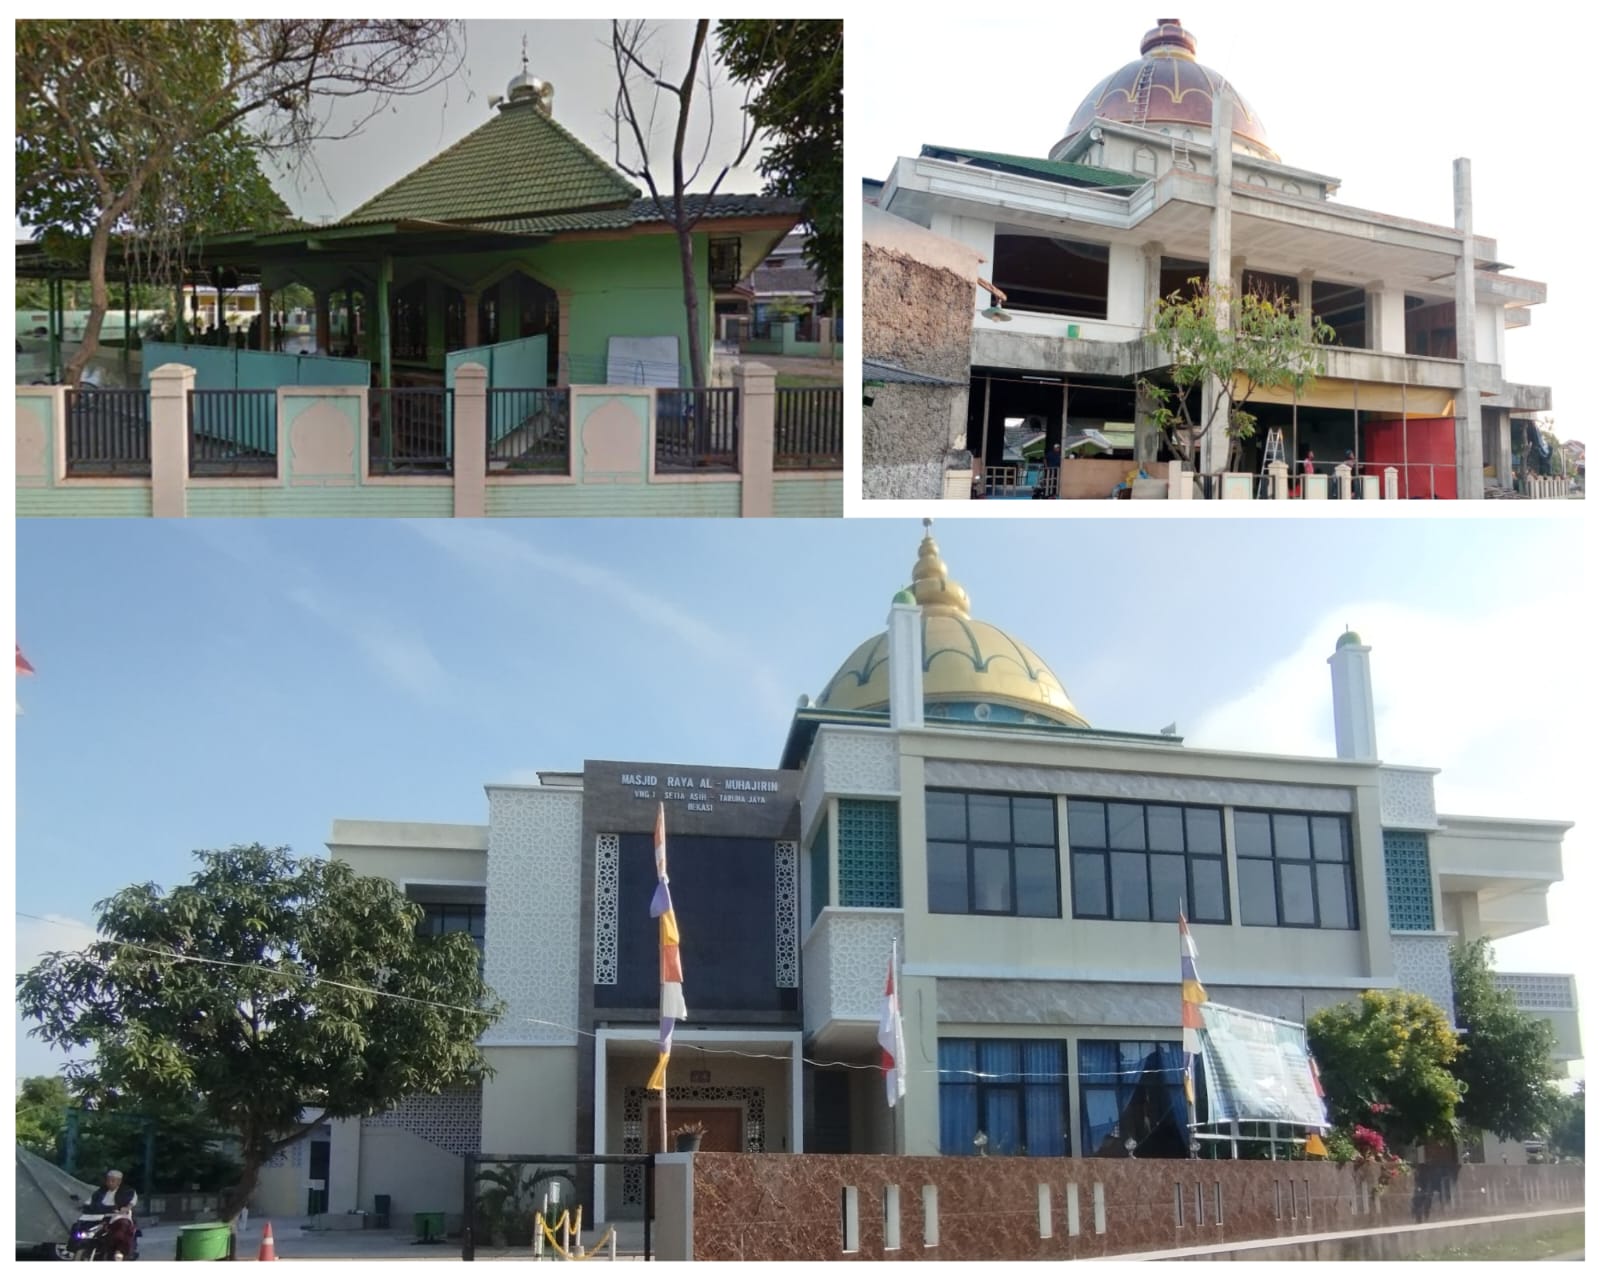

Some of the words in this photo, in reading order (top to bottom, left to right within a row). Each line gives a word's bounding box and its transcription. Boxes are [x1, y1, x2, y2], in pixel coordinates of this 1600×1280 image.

[621, 773, 657, 786] MASJID
[667, 776, 694, 788] RAYA
[700, 778, 712, 789] AL
[725, 780, 778, 792] MUHAJIRIN
[664, 791, 685, 800] SETIA
[689, 793, 707, 801] ASIH
[748, 796, 766, 804] JAYA
[687, 803, 713, 812] BEKASI
